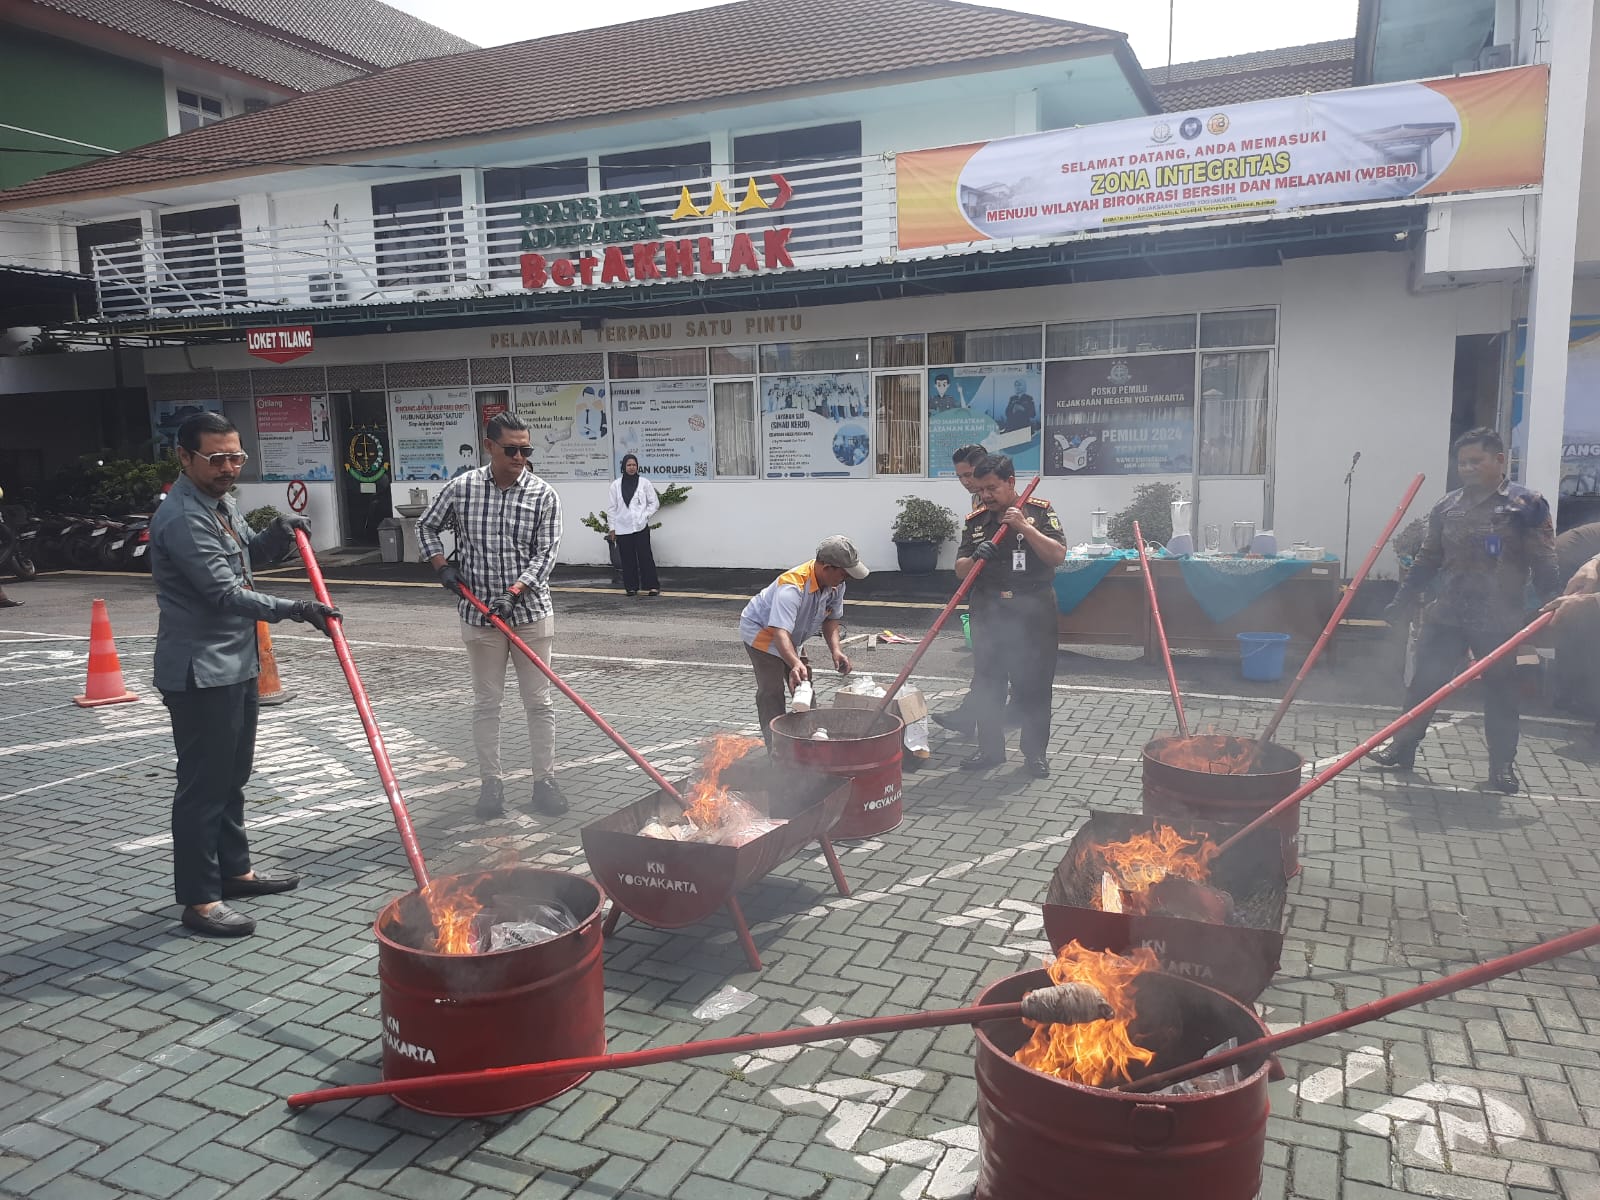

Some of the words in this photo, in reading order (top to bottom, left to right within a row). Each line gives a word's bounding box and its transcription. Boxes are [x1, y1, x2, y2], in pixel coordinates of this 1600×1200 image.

[1061, 156, 1124, 174] SELAMAT
[1129, 148, 1191, 166] DATANG,
[1195, 141, 1236, 157] ANDA
[1241, 131, 1327, 151] MEMASUKI
[1091, 169, 1150, 196] ZONA
[1155, 151, 1291, 188] INTEGRITAS
[986, 205, 1038, 222] MENUJU
[1041, 199, 1099, 216] WILAYAH
[1103, 190, 1178, 208] BIROKRASI
[1182, 182, 1235, 199] BERSIH
[1239, 178, 1271, 193] DAN
[1275, 170, 1351, 190] MELAYANI
[1355, 162, 1418, 183] (WBBM)
[519, 226, 795, 290] BerAKHLAK
[248, 332, 277, 349] LOKET
[278, 330, 312, 348] TILANG
[490, 328, 583, 349] PELAYANAN
[597, 322, 673, 344] TERPADU
[685, 318, 733, 338] SATU
[746, 314, 803, 335] PINTU
[1091, 386, 1117, 396] POSKO
[1119, 384, 1148, 395] PEMILU
[1056, 398, 1102, 408] KEJAKSAAN
[1103, 396, 1132, 406] NEGERI
[1134, 394, 1185, 404] YOGYAKARTA
[1101, 428, 1149, 442] PEMILU
[1151, 427, 1183, 442] 2024
[653, 465, 691, 474] KORUPSI
[647, 861, 665, 875] KN
[617, 872, 698, 894] YOGYAKARTA
[1141, 939, 1166, 954] KN
[386, 1015, 400, 1034] KN
